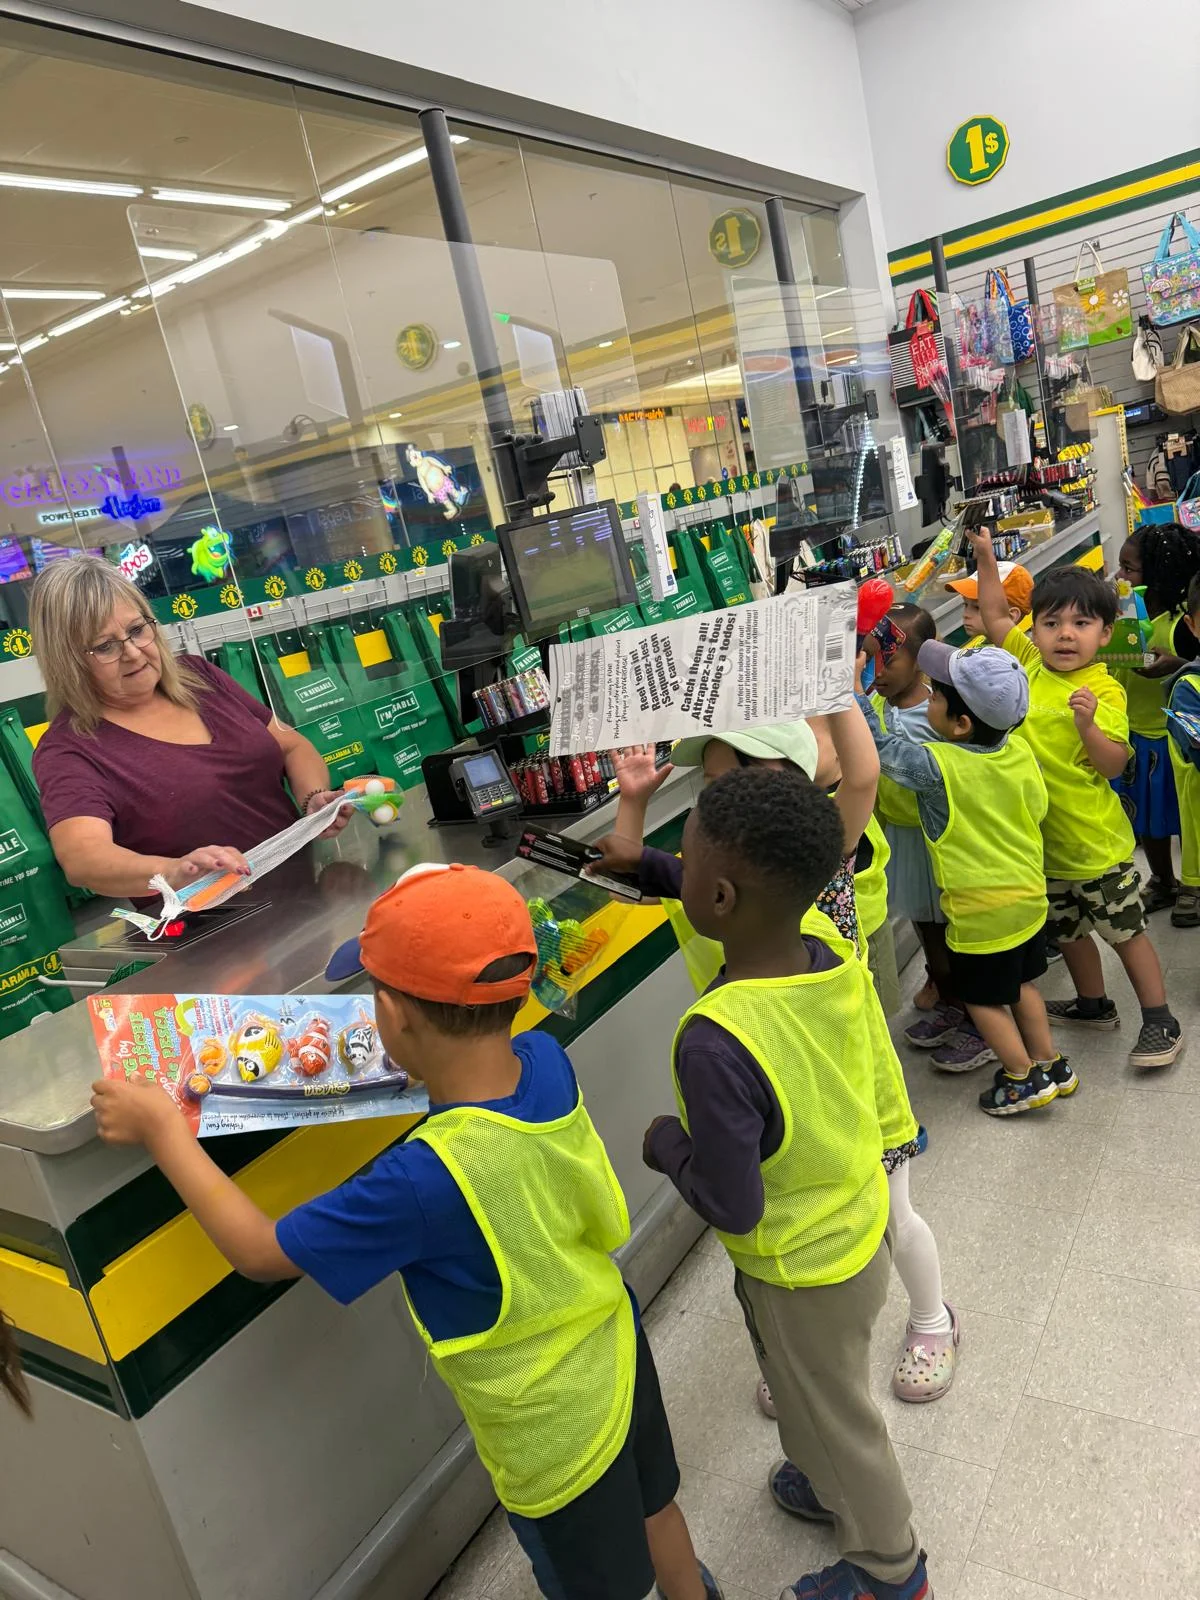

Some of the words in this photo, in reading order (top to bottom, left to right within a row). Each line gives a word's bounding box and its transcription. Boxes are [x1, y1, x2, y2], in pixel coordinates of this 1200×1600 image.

[911, 336, 932, 355] EAT
[42, 509, 89, 522] POWERED
[651, 633, 660, 653] con
[630, 649, 639, 664] in!
[661, 636, 677, 678] carrete!
[680, 678, 696, 712] Catch
[689, 645, 704, 674] them
[699, 622, 709, 642] all!
[691, 646, 716, 720] Attrapez-les
[709, 617, 723, 643] tous
[639, 639, 660, 711] Ramenez-les!
[655, 656, 674, 707] ¡Sáquelos
[702, 665, 724, 728] ¡Atrápelos
[719, 613, 736, 651] todos!
[670, 681, 679, 691] el
[638, 687, 649, 711] Reel
[380, 710, 393, 722] I'M
[26, 867, 39, 877] SHOP
[0, 966, 39, 991] ARAMA
[129, 1012, 153, 1065] PÊCHE
[154, 1008, 175, 1058] PESCA
[116, 1040, 136, 1057] toy
[221, 1120, 243, 1129] Fishing
